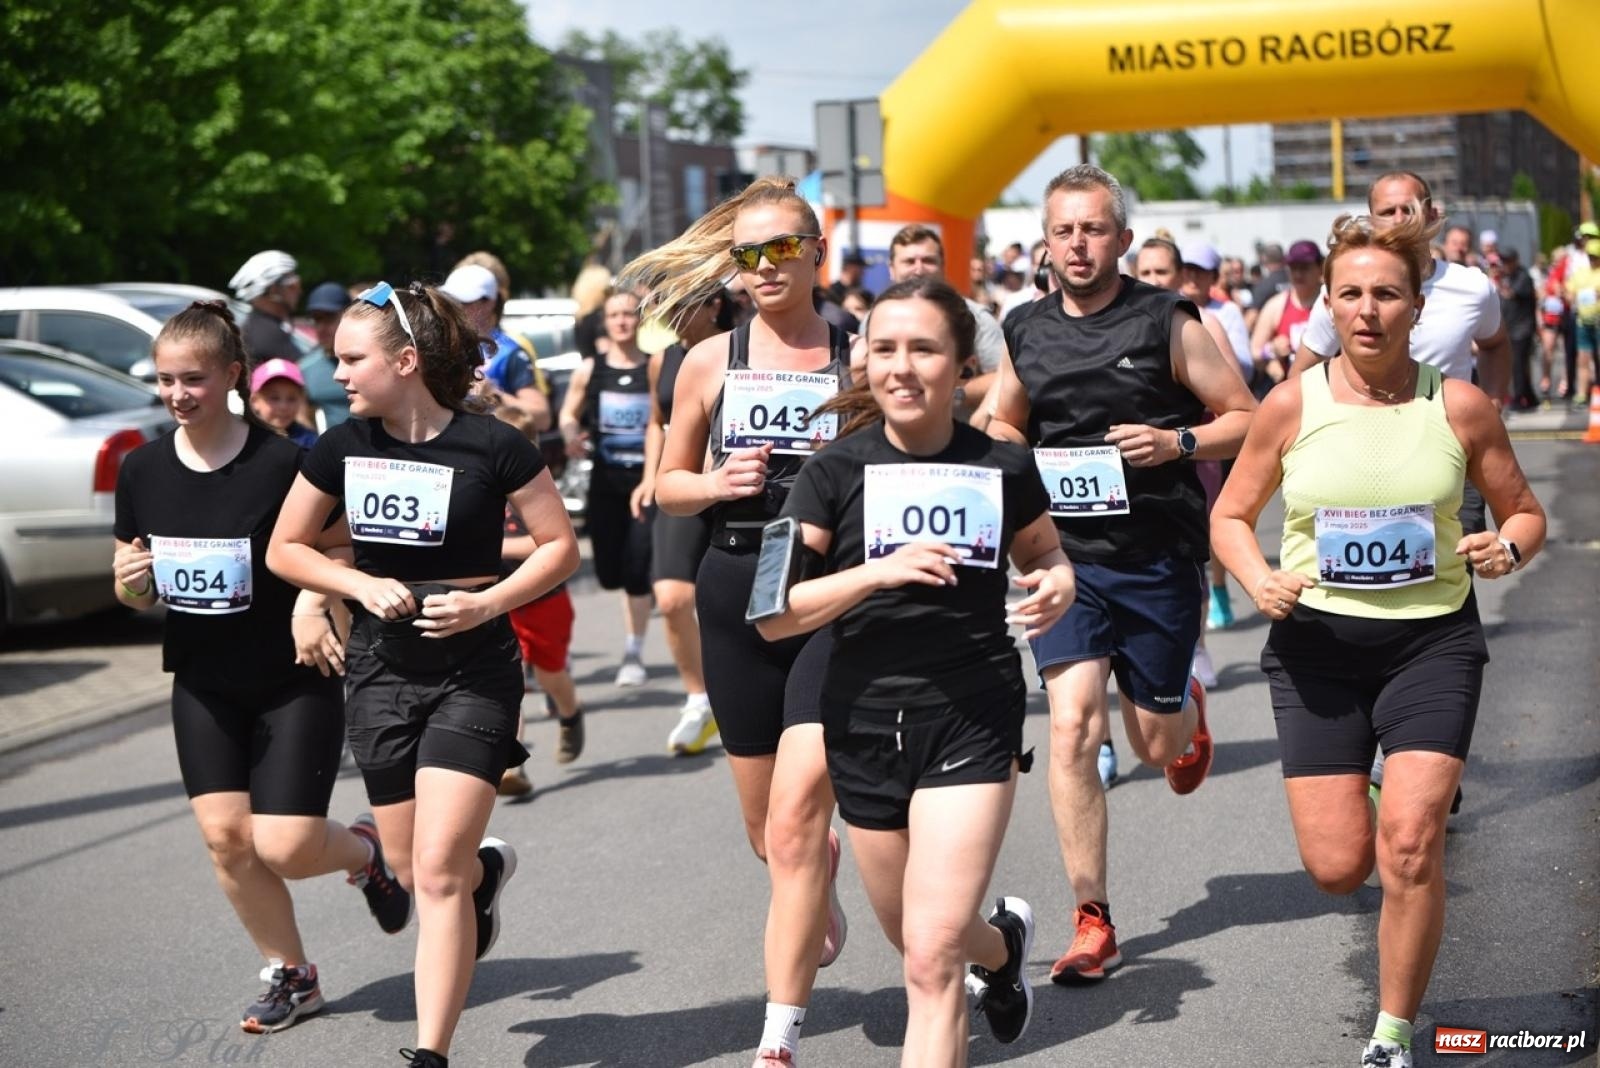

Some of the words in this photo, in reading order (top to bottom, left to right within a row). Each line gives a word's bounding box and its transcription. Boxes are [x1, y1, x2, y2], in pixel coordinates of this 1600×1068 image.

[1108, 37, 1247, 73] MIASTO
[1259, 21, 1455, 64] RACIBÓRZ
[734, 373, 751, 381] XVII
[752, 373, 774, 381] BIEG
[775, 373, 793, 382] BEZ
[794, 374, 830, 385] GRANIC
[749, 404, 810, 433] 043
[1084, 448, 1114, 456] GRANIC
[366, 460, 388, 470] BIEG
[389, 462, 407, 471] BEZ
[408, 464, 445, 476] GRANIC
[952, 468, 991, 481] GRANIC
[1059, 475, 1101, 498] 031
[363, 492, 420, 523] 063
[1324, 509, 1342, 518] XVII
[1344, 510, 1367, 519] BIEG
[1369, 509, 1387, 518] BEZ
[1389, 505, 1426, 517] GRANIC
[902, 504, 967, 538] 001
[193, 540, 209, 548] BEZ
[209, 539, 243, 549] GRANIC
[1344, 538, 1410, 568] 004
[174, 568, 228, 594] 054
